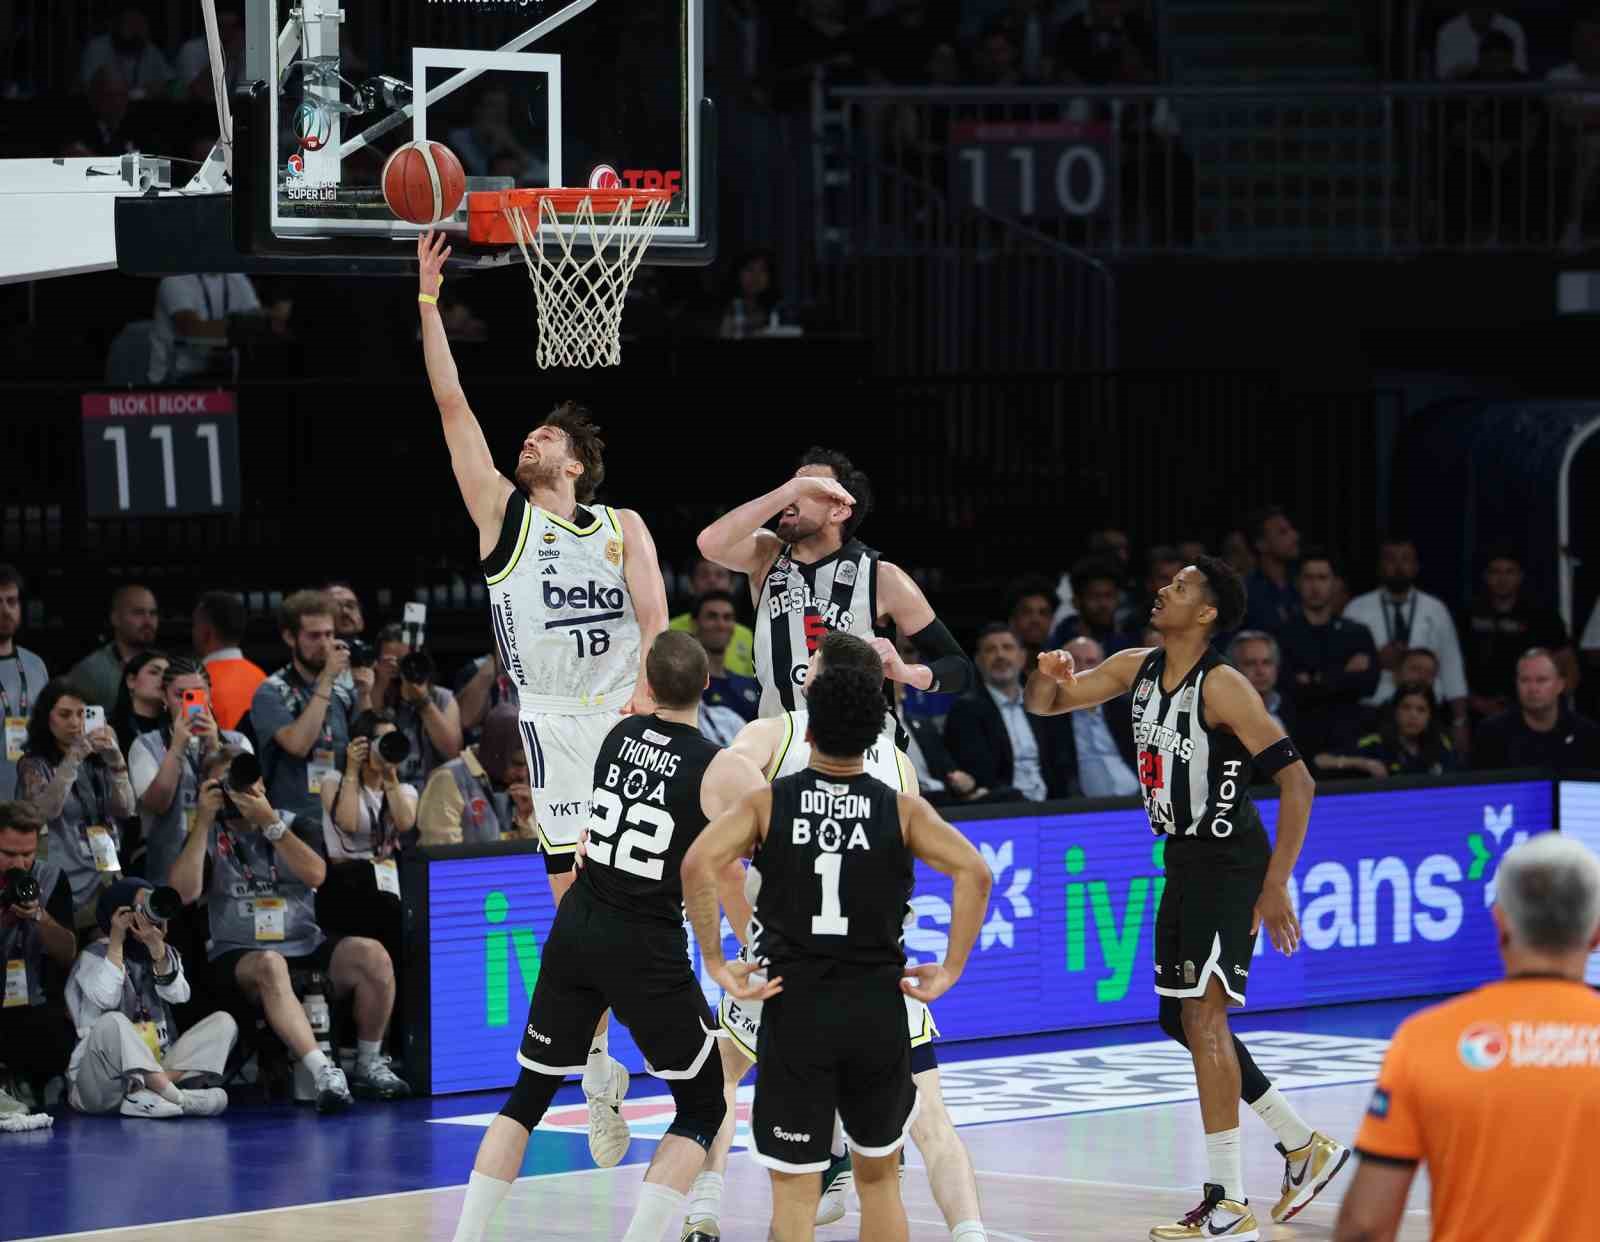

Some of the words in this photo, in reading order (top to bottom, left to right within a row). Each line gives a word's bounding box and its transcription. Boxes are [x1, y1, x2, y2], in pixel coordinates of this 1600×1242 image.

[960, 147, 1105, 216] 110
[109, 396, 147, 416] BLOK
[159, 393, 208, 415] BLOCK
[103, 423, 223, 511] 111
[538, 549, 560, 557] beko
[542, 580, 624, 609] beko
[503, 591, 517, 649] ACADEMY
[569, 629, 610, 658] 18
[617, 736, 682, 777] THOMAS
[1139, 751, 1164, 790] 21
[801, 789, 870, 819] DOTSON
[586, 787, 675, 881] 22
[811, 851, 849, 936] 1
[527, 1023, 552, 1045] Govee
[773, 1126, 811, 1143] Govee
